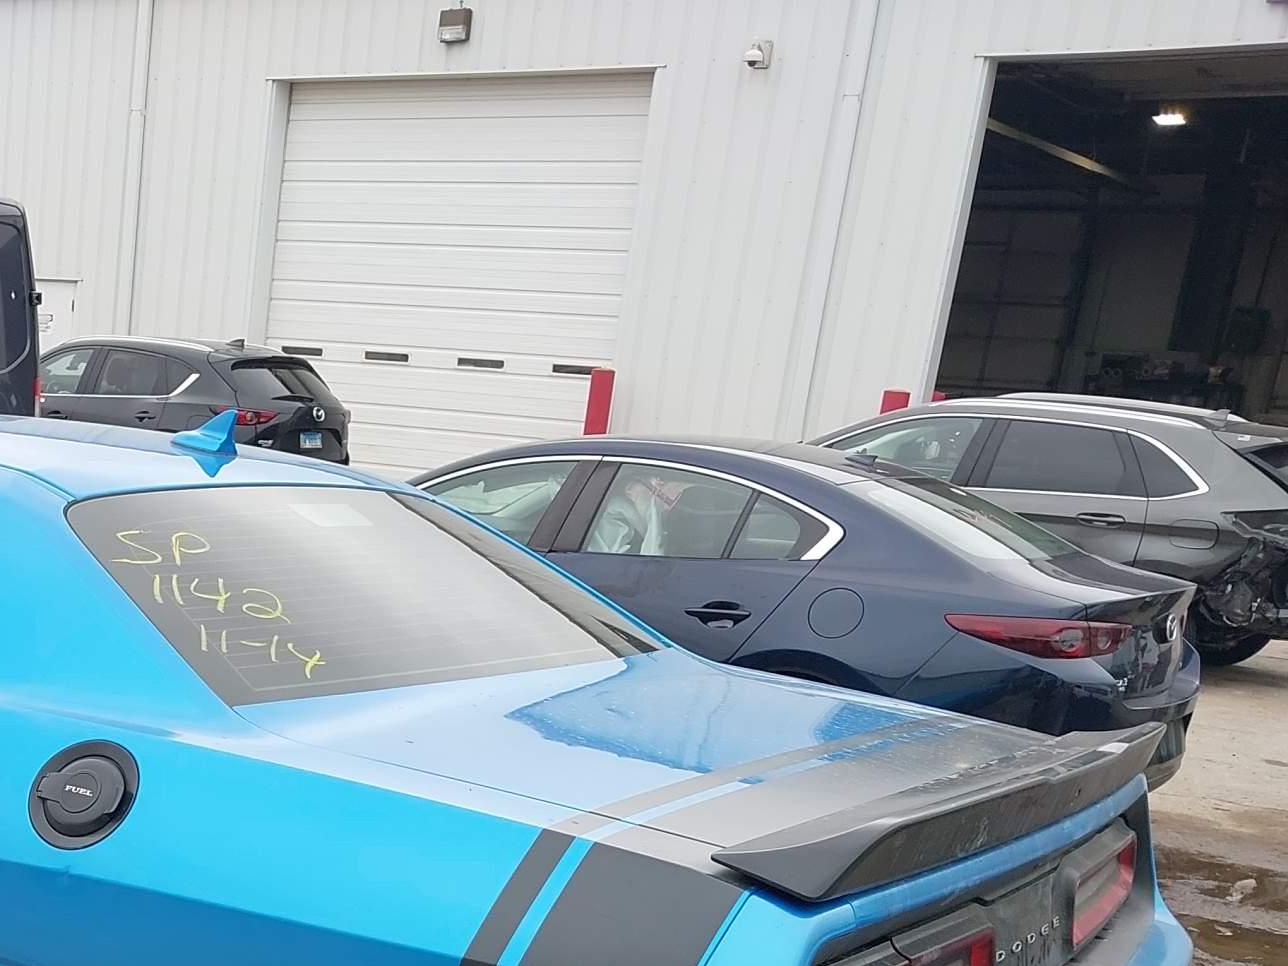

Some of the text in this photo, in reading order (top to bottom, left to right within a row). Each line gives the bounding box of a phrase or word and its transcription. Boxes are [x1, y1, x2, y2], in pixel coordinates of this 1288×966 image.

[111, 530, 211, 567] SP
[153, 573, 292, 625] 1142
[199, 624, 327, 680] 11-14
[64, 784, 94, 797] FUEL
[995, 915, 1061, 962] DODGE
